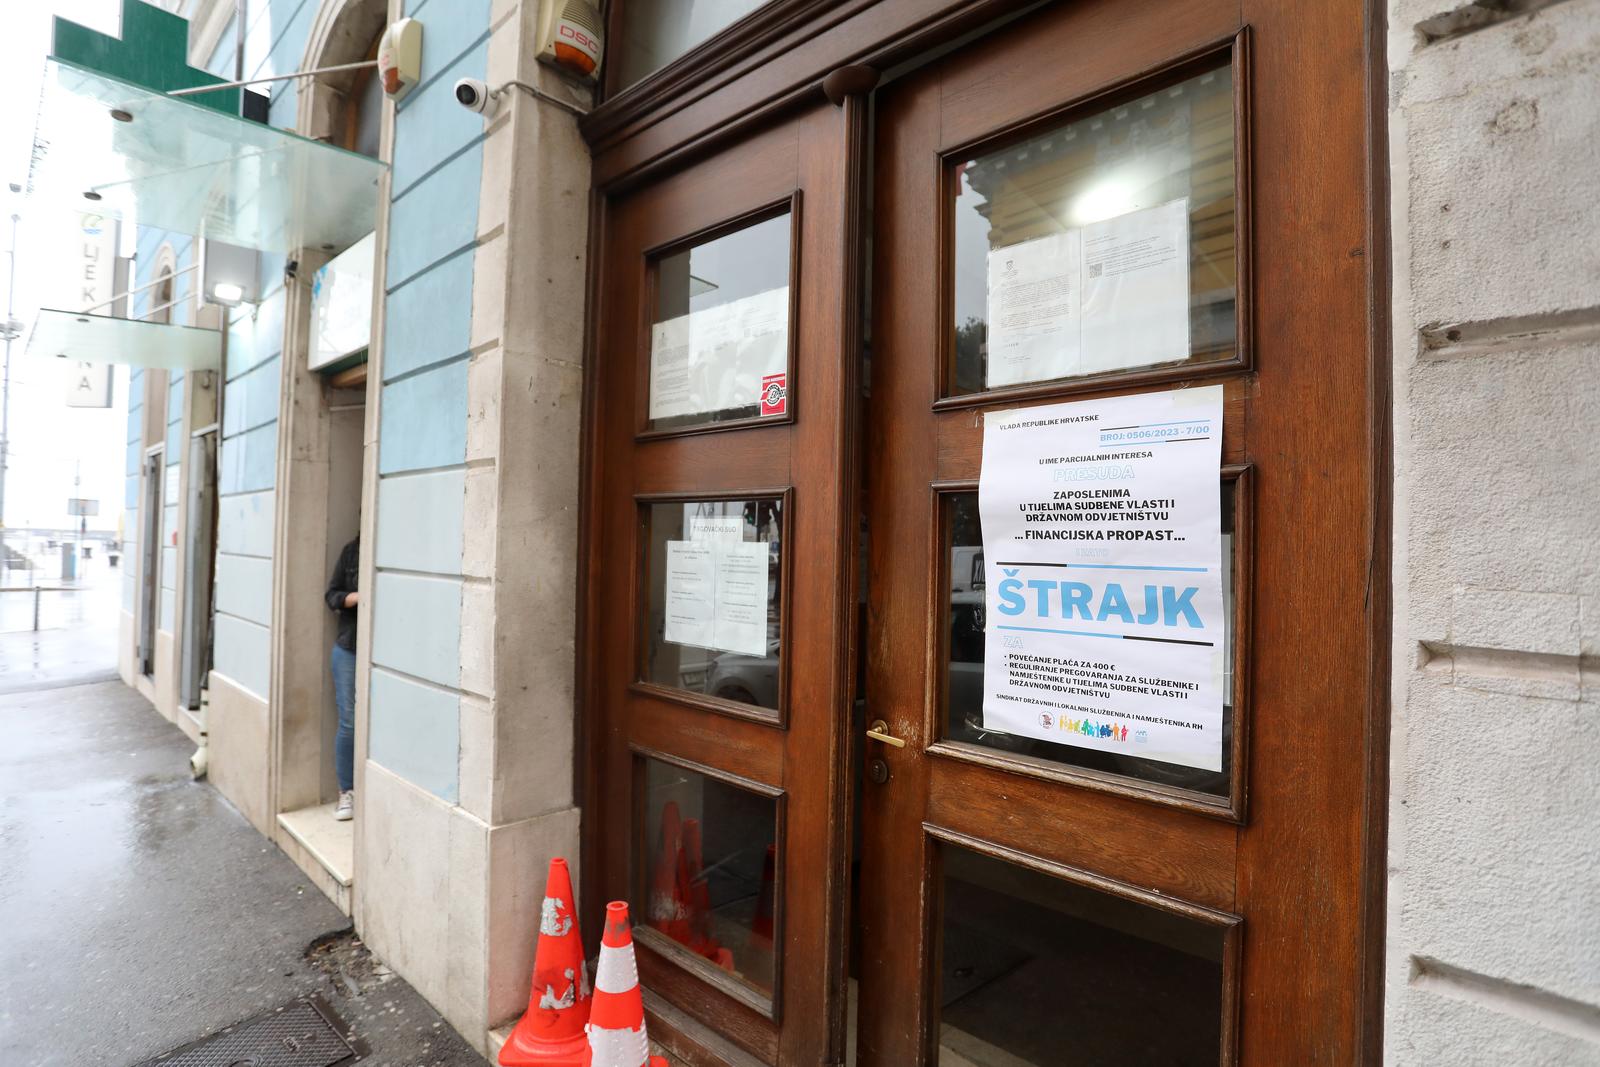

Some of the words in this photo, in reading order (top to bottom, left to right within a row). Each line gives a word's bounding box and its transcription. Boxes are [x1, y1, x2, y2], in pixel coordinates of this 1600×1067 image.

[560, 24, 599, 54] DSC
[76, 240, 101, 392] LJEKNA
[999, 423, 1021, 431] VLADA
[1022, 418, 1059, 428] REPUBLIKE
[1060, 414, 1100, 424] HRVATSKE
[1100, 433, 1125, 441] BROJ:
[1127, 428, 1179, 440] 0506/2023
[1186, 425, 1210, 435] 7/00
[1045, 457, 1059, 465] IME
[1060, 454, 1110, 464] PARCIJALNIH
[1111, 451, 1153, 460] INTERESA
[1053, 464, 1136, 481] PRESUDA
[1053, 488, 1131, 500] ZAPOSLENIMA
[1019, 503, 1027, 512] U
[1027, 502, 1073, 512] TIJELIMA
[1074, 500, 1125, 511] SUDBENE
[1126, 499, 1169, 509] VLASTI
[1171, 499, 1175, 508] I
[1025, 511, 1083, 522] DRŽAVNOM
[1085, 510, 1169, 521] ODVJETNIŠTVU
[997, 568, 1204, 628] ŠTRAJK
[1003, 635, 1024, 648] ZA
[1009, 653, 1052, 664] POVEĆANJE
[1053, 658, 1079, 667] PLAĆA
[1080, 661, 1092, 669] ZA
[1093, 662, 1109, 671] 400
[1009, 662, 1059, 674] REGULIRANJE
[1060, 667, 1124, 682] PREGOVARANJA
[1125, 675, 1137, 684] ZA
[1138, 676, 1194, 690] SLUŽBENIKE
[1195, 683, 1199, 691] I
[1009, 671, 1065, 684] NAMJEŠTENIKE
[1072, 678, 1108, 689] TIJELIMA
[1110, 683, 1150, 695] SUDBENE
[1151, 688, 1183, 699] VLASTI
[1009, 679, 1051, 691] DRŽAVNOM
[1052, 684, 1111, 699] ODVJETNIŠTVU
[996, 693, 1023, 703] SINDIKAT
[1023, 697, 1053, 707] DRŽAVNIH
[1057, 702, 1089, 713] LOKALNIH
[1089, 707, 1131, 720] SLUŽBENIKA
[1136, 715, 1191, 729] NAMJEŠTENIKA
[1192, 723, 1203, 731] RH
